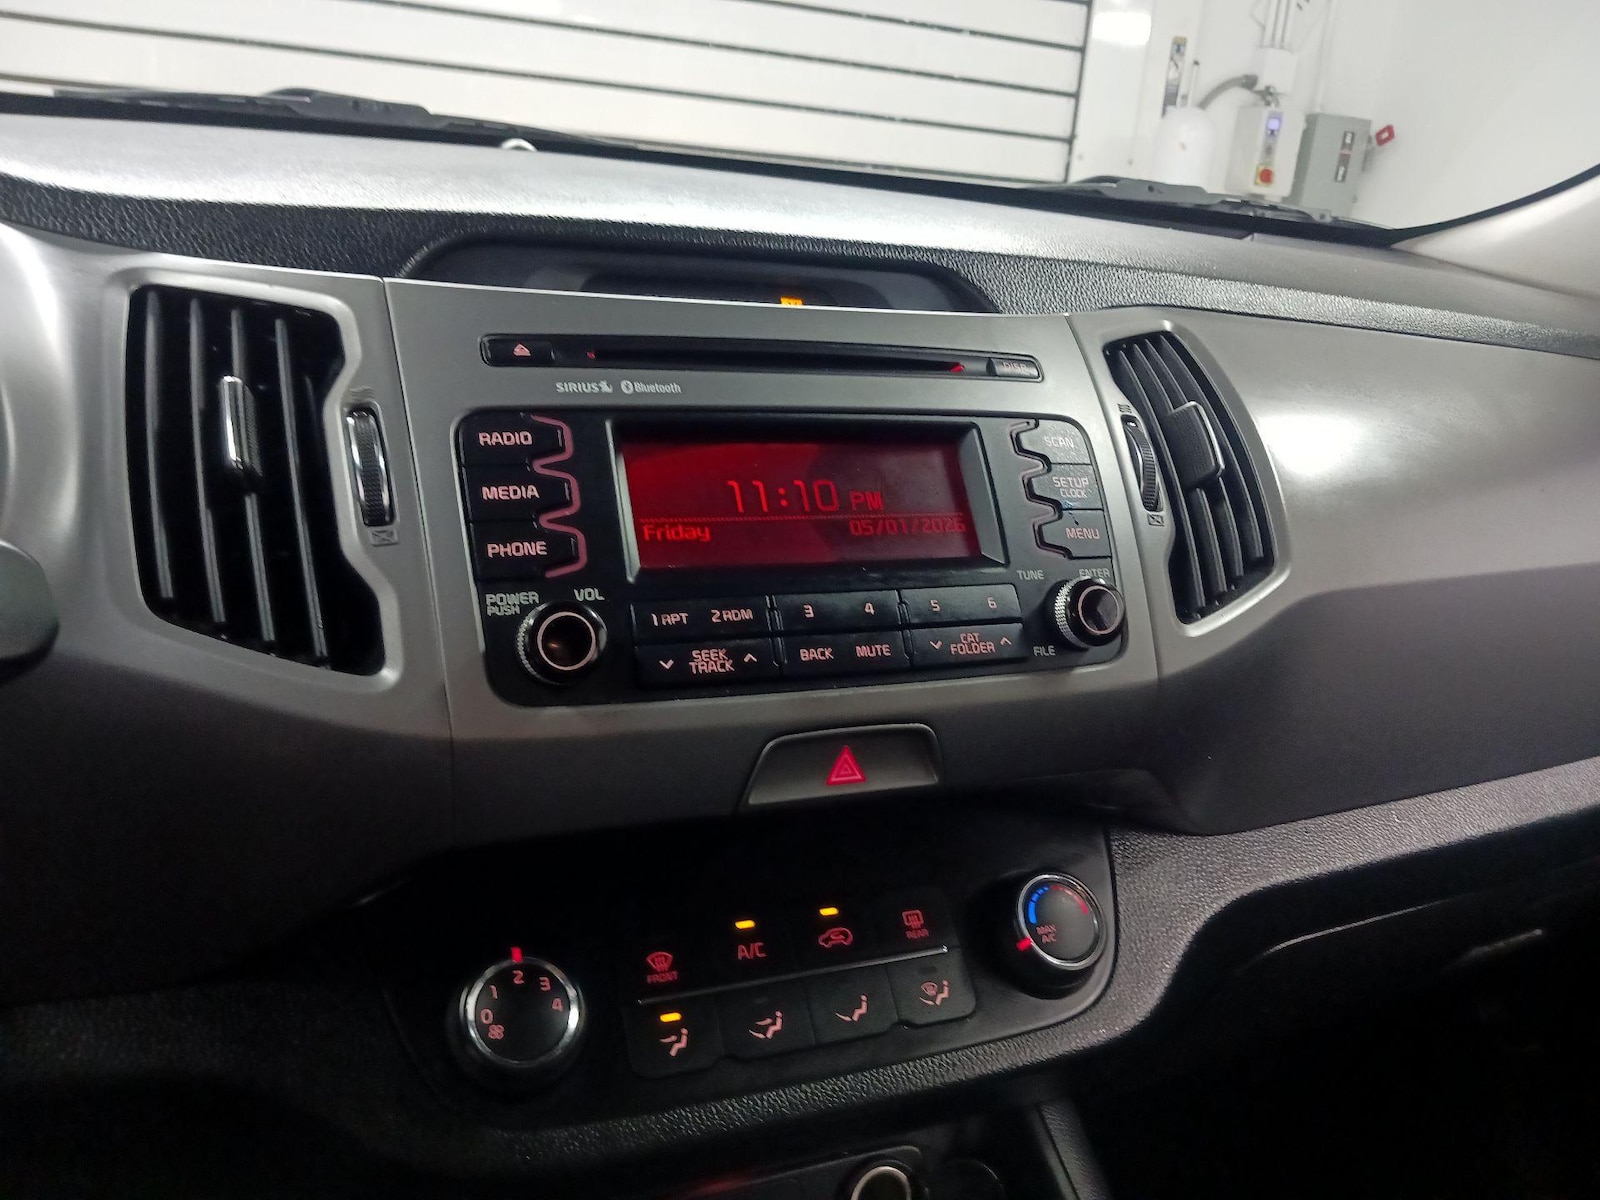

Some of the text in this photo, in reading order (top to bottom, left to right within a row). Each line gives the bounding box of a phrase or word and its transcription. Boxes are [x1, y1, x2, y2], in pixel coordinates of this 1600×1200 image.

[634, 382, 682, 394] Bluetooth
[478, 431, 533, 446] RADIO
[1043, 435, 1074, 448] SCAN
[1052, 476, 1088, 489] SETUP
[482, 484, 540, 501] MEDIA
[727, 479, 884, 513] 11:10 PM
[1060, 487, 1088, 499] CLOCK
[643, 524, 711, 542] Friday
[1065, 527, 1100, 540] MENU
[487, 540, 548, 558] PHONE
[1016, 569, 1045, 581] TUNE
[485, 591, 540, 607] POWER
[573, 588, 605, 602] VOL
[987, 596, 998, 609] 6
[486, 604, 521, 617] PUSH
[803, 603, 815, 619] 3
[863, 602, 876, 616] 4
[930, 599, 941, 612] 5
[959, 632, 981, 644] CAT
[691, 648, 728, 662] SEEK
[799, 647, 835, 662] BACK
[855, 643, 892, 658] MUTE
[950, 641, 996, 656] FOLDER
[1033, 645, 1056, 657] FILE
[688, 660, 735, 675] TRACK
[737, 942, 766, 960] A/C
[512, 969, 525, 985] 2
[538, 976, 552, 992] 3
[489, 984, 499, 1000] 1
[551, 997, 564, 1013] 4
